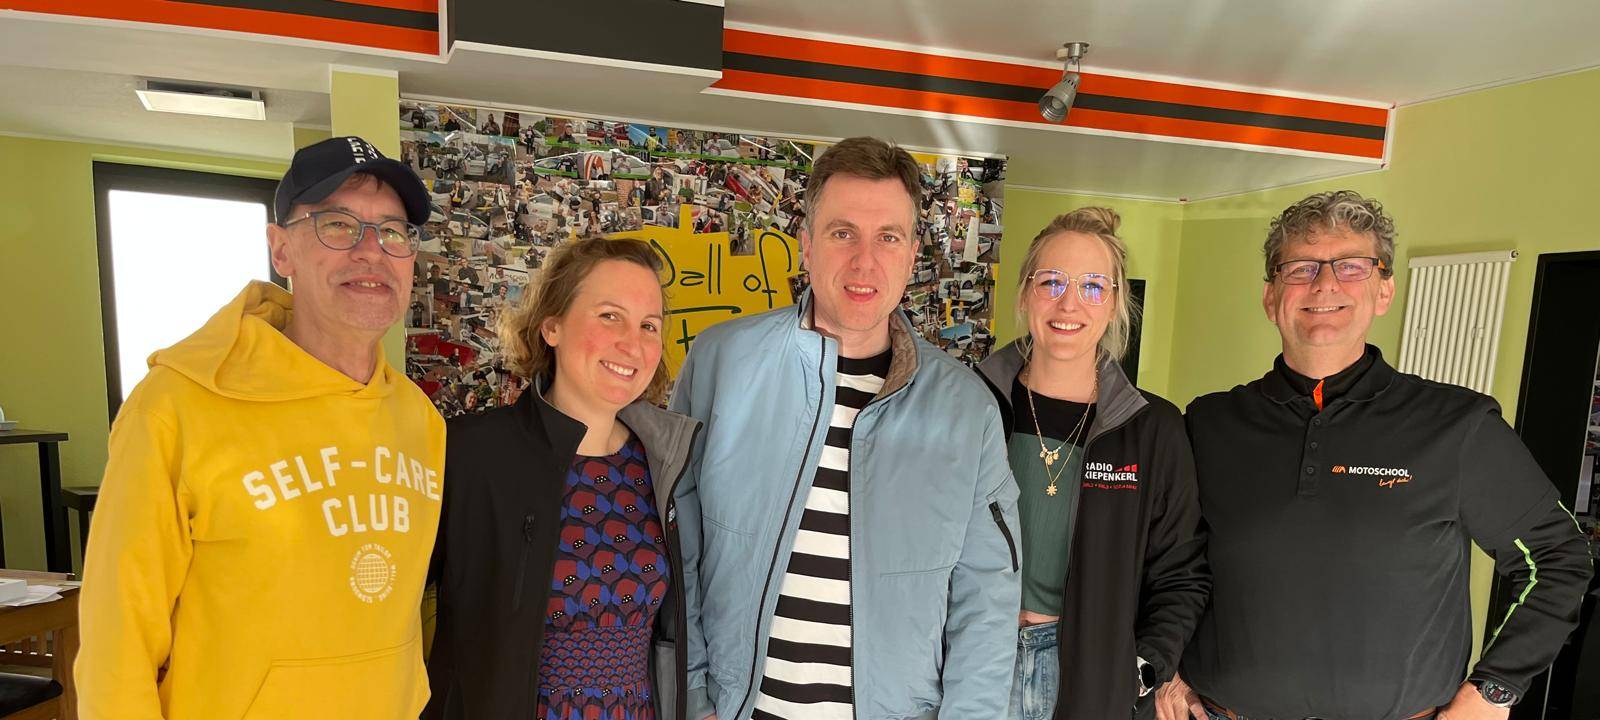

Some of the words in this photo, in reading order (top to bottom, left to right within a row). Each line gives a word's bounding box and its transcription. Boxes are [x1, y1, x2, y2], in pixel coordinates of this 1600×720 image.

[743, 231, 792, 309] of
[242, 446, 441, 510] SELF-CARE
[1348, 466, 1410, 477] MOTOSCHOOL
[322, 494, 410, 537] CLUB
